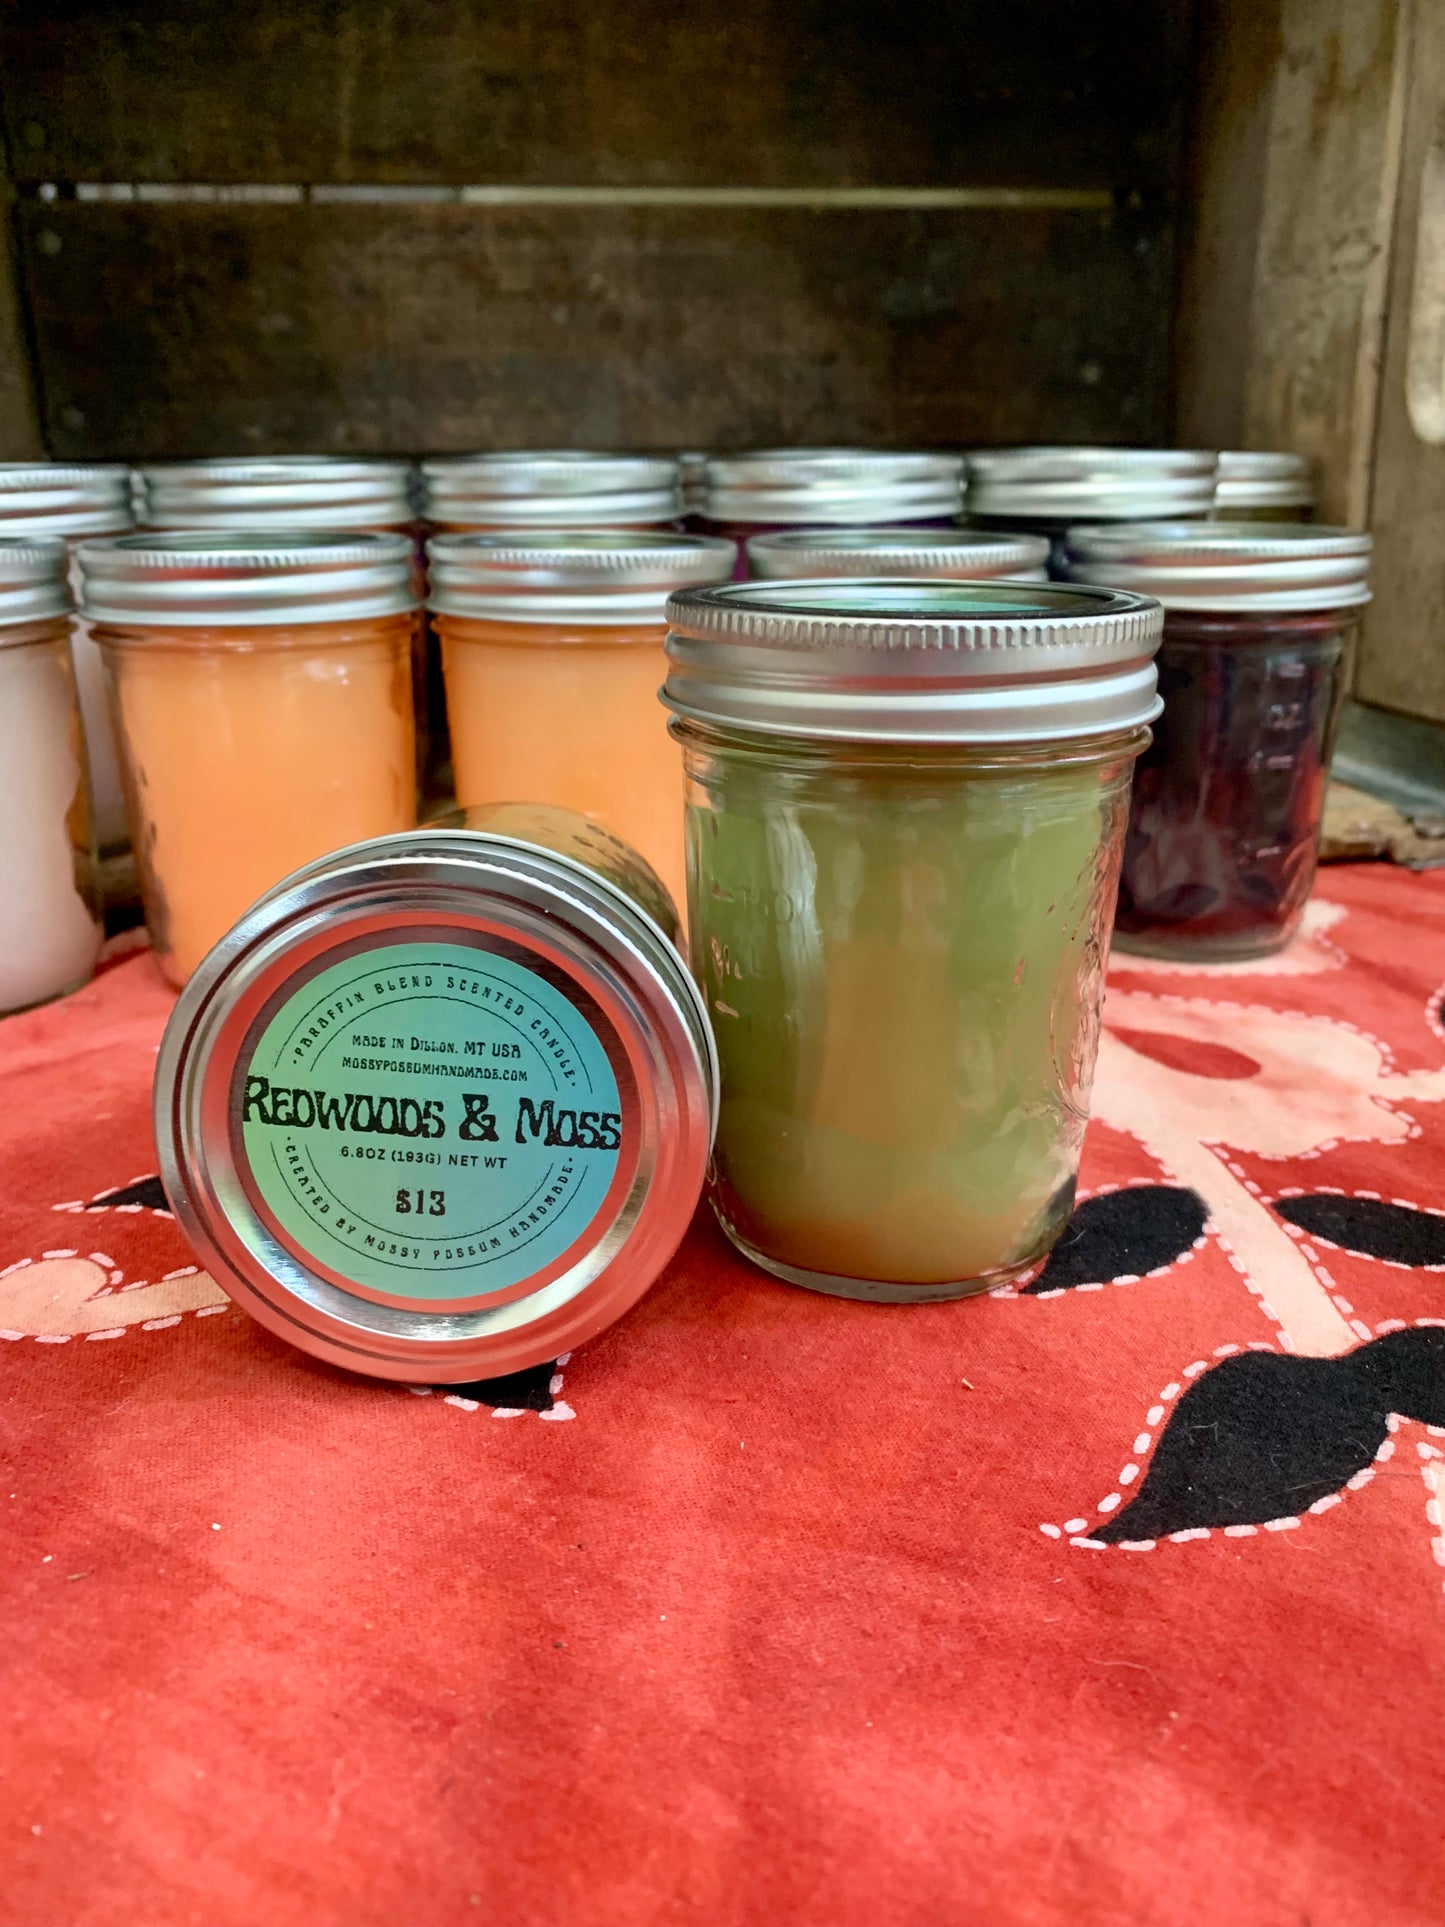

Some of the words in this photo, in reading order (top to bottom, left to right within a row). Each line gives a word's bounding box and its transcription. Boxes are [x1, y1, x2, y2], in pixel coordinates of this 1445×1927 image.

[294, 992, 364, 1057] PARAFFIN
[374, 976, 433, 995] BLEND
[446, 976, 525, 1017] SCENTED
[530, 1018, 577, 1079] CANDLE
[352, 1035, 387, 1048] MADE
[391, 1037, 405, 1049] IN
[464, 1041, 486, 1056] MT
[492, 1043, 522, 1059] USA
[342, 1056, 528, 1082] MOSSYPOSSUMHANDMADE.COM
[459, 1094, 499, 1142] &
[448, 1154, 479, 1167] NET
[484, 1156, 508, 1169] WT
[285, 1144, 331, 1214] CREATED
[335, 1217, 357, 1235] BY
[364, 1234, 420, 1259] MOSSY
[433, 1237, 502, 1260] POSSUM
[508, 1164, 574, 1238] HANDMADE
[396, 1189, 446, 1216] $13
